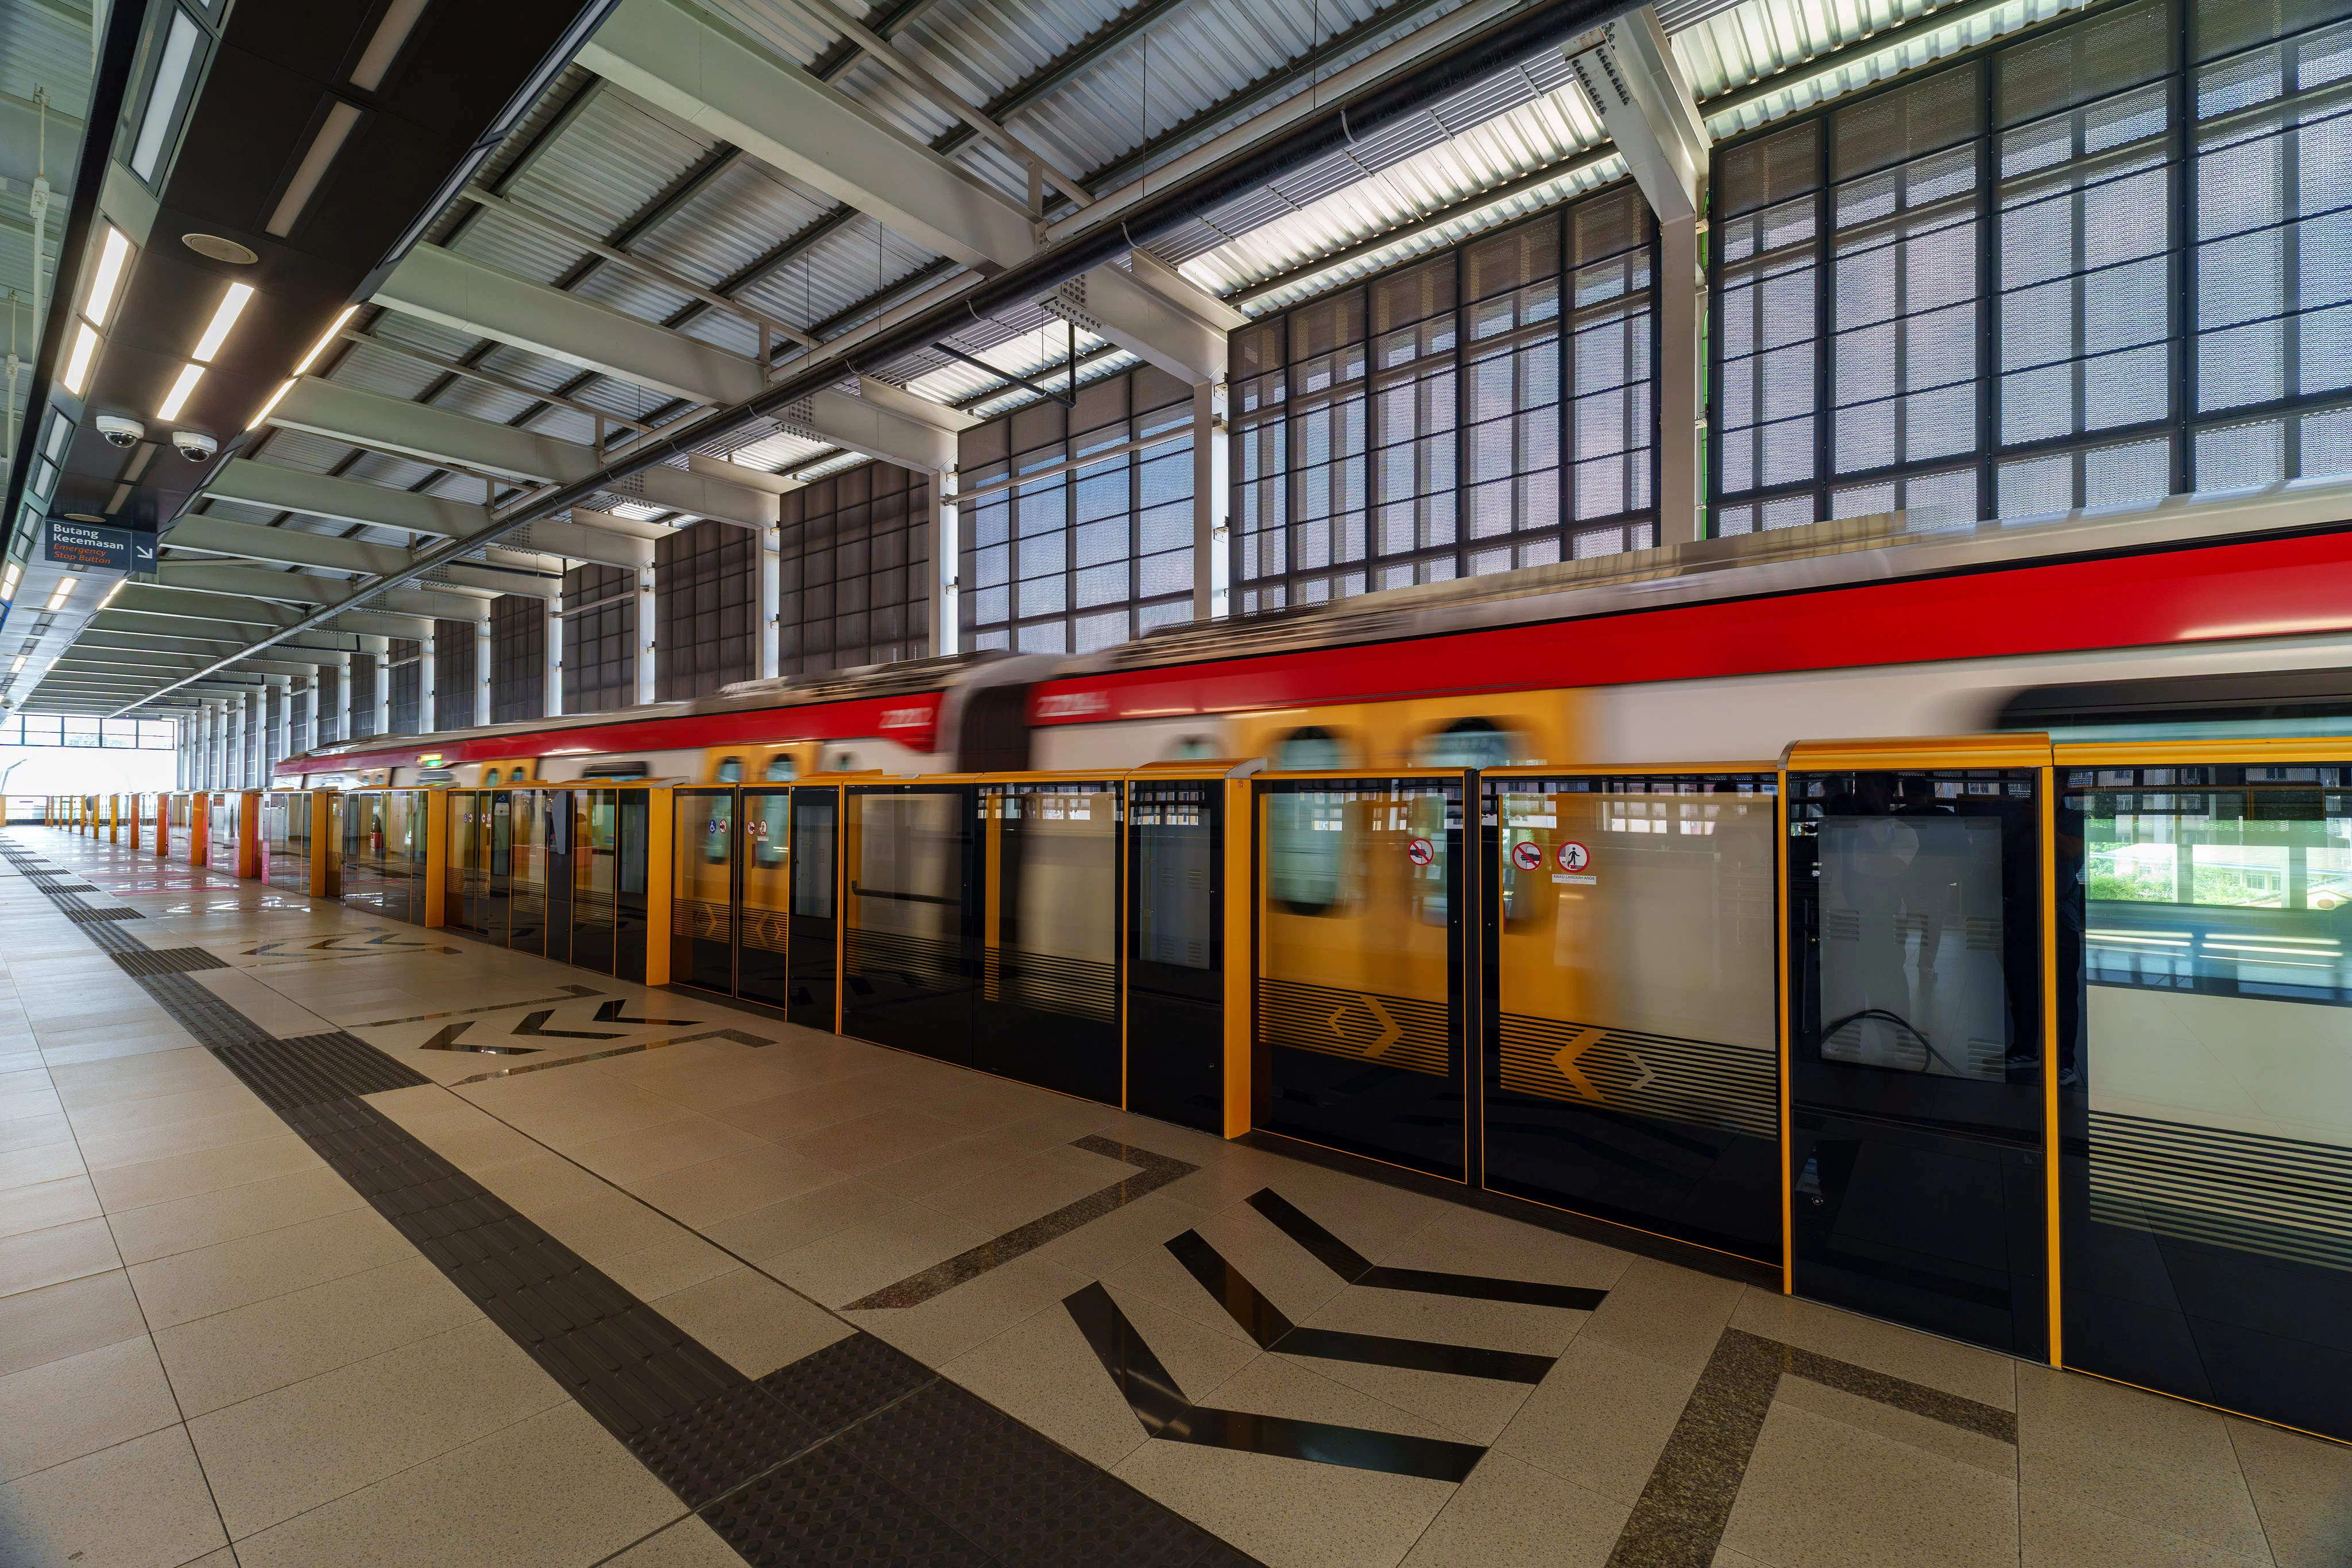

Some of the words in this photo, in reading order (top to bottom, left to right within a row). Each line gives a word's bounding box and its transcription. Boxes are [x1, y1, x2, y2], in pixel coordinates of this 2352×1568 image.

[53, 524, 99, 539] Butang
[53, 533, 124, 550] Kecemasan
[53, 543, 106, 557] Emergency
[53, 551, 76, 560] Stop
[79, 554, 111, 564] Button
